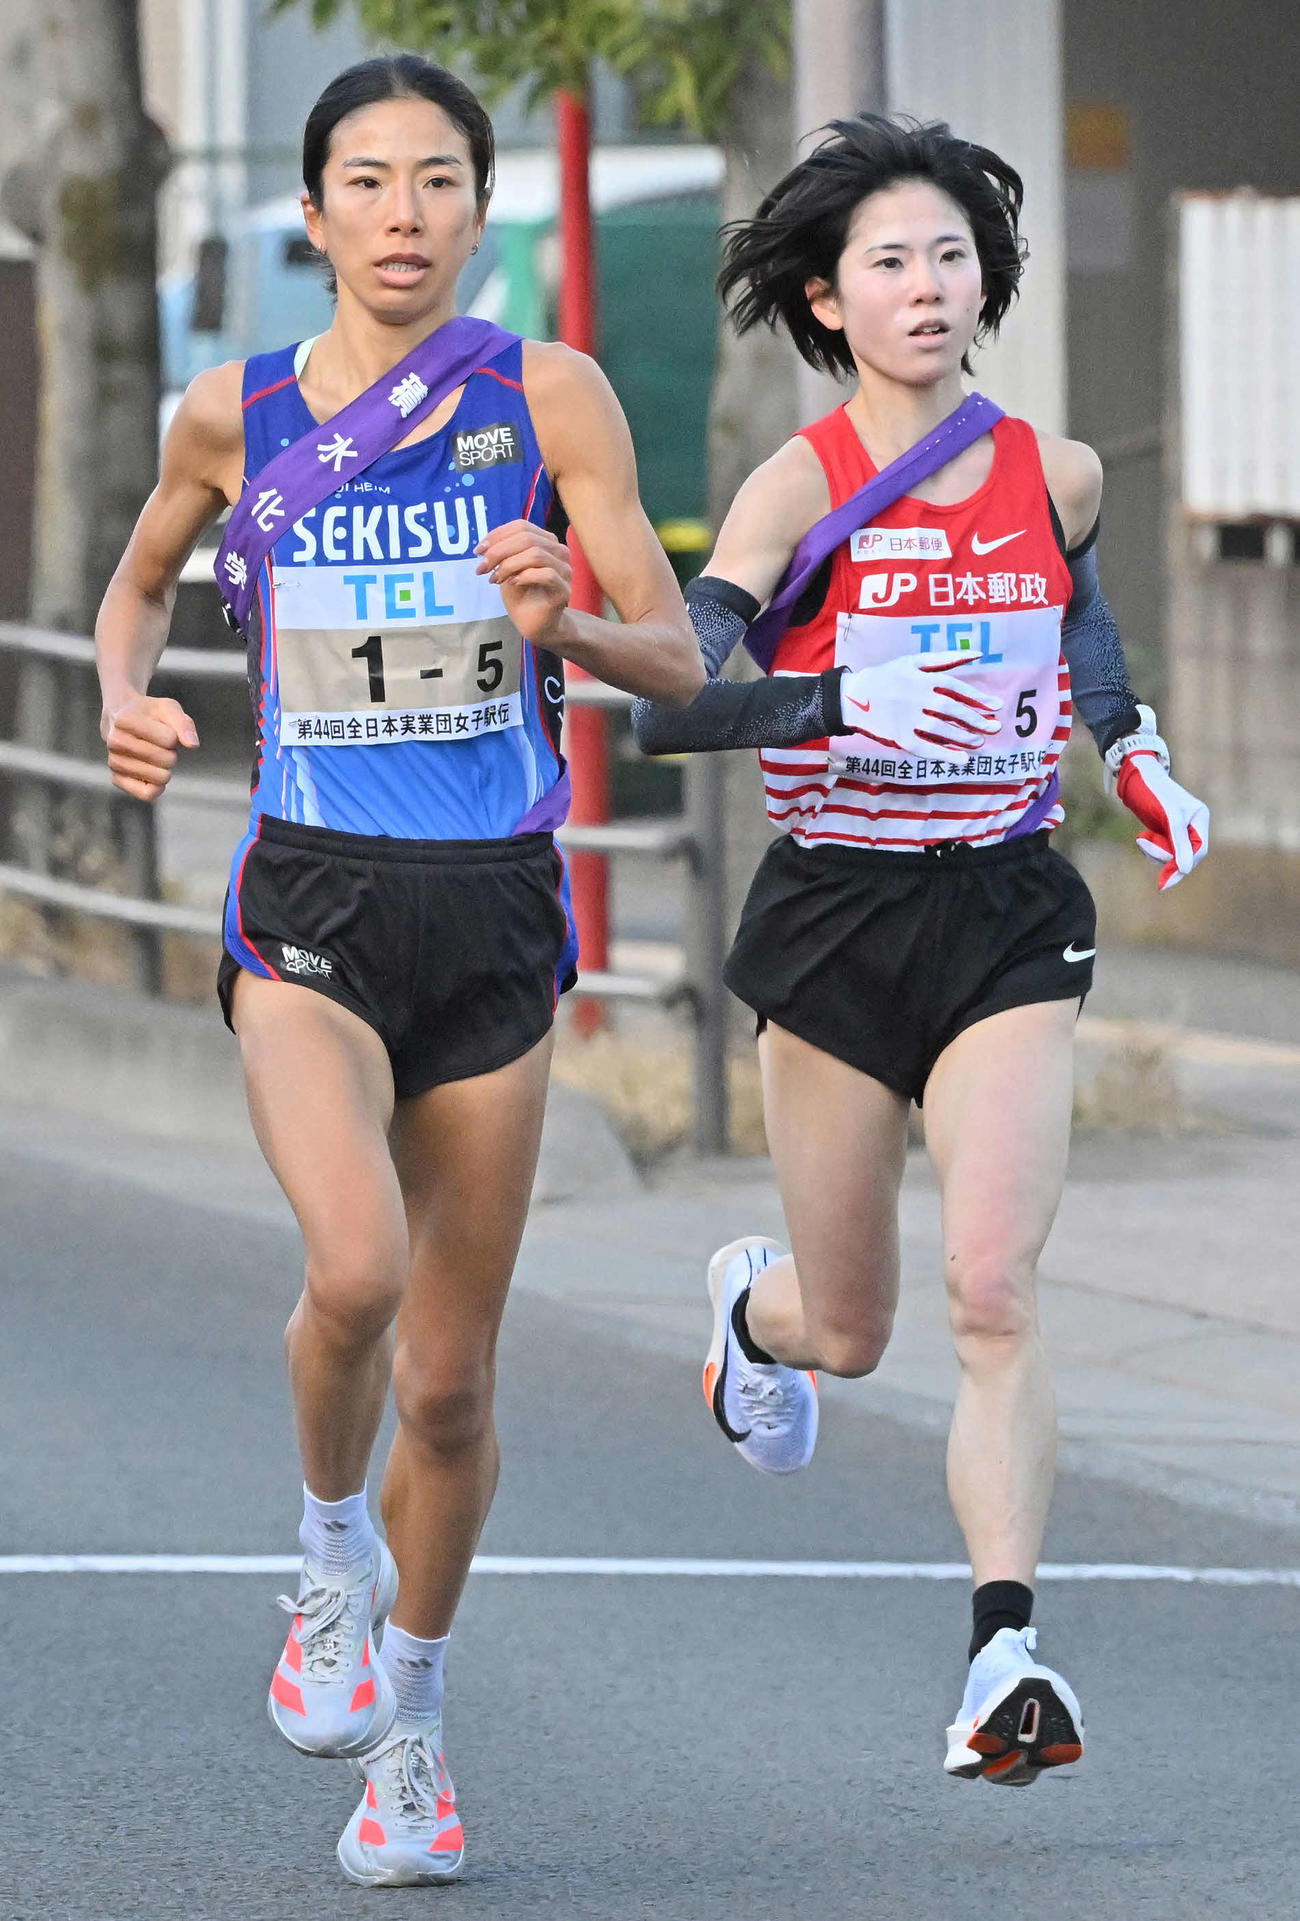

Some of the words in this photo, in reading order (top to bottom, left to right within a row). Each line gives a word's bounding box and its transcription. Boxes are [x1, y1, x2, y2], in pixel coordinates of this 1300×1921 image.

[456, 427, 513, 452] MOVE
[459, 442, 515, 467] SPORT
[354, 482, 391, 494] HEIM
[292, 495, 489, 563] SEKISUI
[890, 536, 944, 551] 日本郵便
[343, 571, 455, 621] TEL
[858, 572, 918, 609] JP
[929, 572, 1049, 606] 日本郵政
[297, 703, 510, 740] 第44回全日本実業団女子駅伝
[1015, 689, 1037, 738] 5
[281, 946, 333, 970] MOVE
